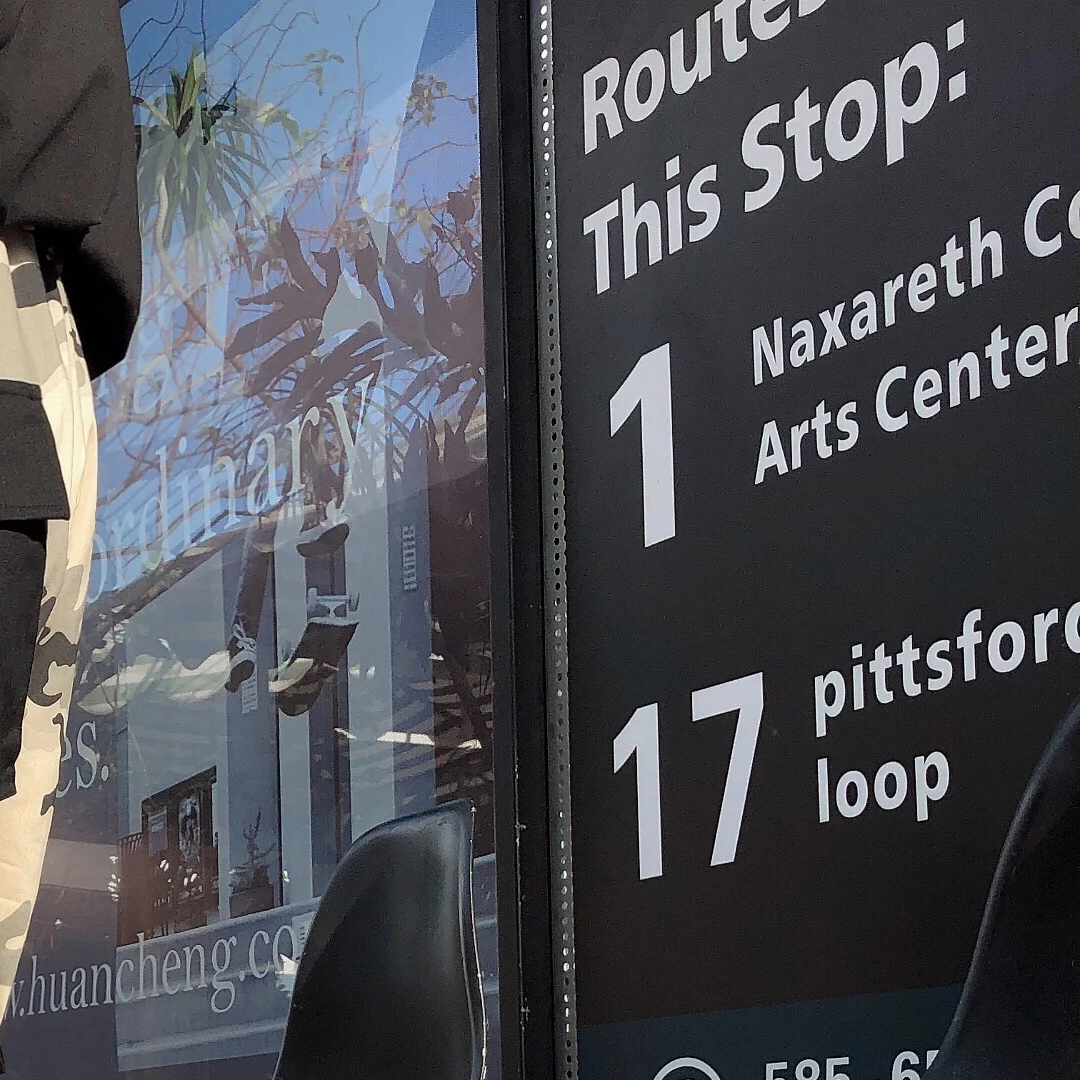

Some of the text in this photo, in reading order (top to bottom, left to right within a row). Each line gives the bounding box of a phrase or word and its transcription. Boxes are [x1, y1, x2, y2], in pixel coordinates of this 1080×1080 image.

[583, 0, 824, 155] Route
[583, 19, 967, 294] This Stop:
[752, 216, 1004, 386] Naxareth
[610, 343, 676, 547] 1
[754, 306, 1079, 485] Arts Center
[613, 672, 764, 880] 17
[817, 751, 950, 823] loop
